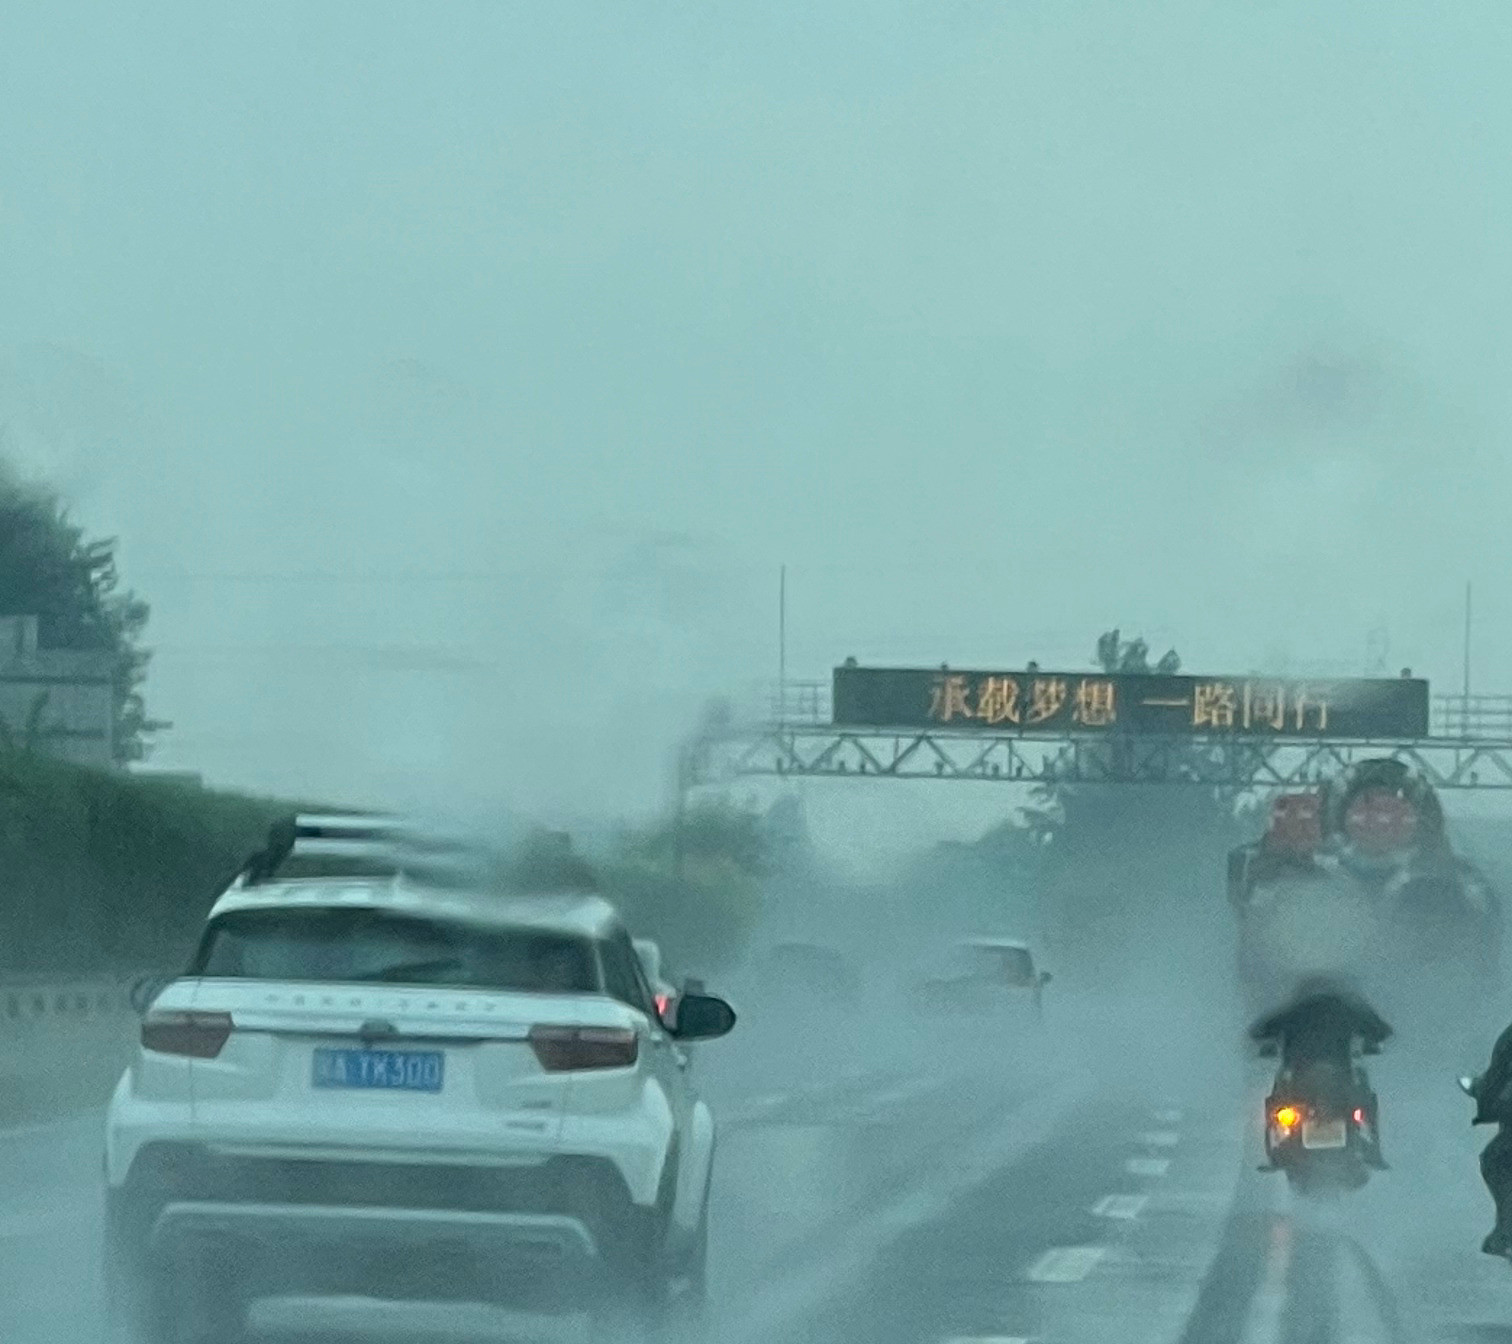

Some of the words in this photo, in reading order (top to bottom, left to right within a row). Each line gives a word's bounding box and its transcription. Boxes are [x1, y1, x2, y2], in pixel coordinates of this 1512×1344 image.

[929, 674, 1117, 727] 承载梦想
[1141, 682, 1331, 731] 一路同行
